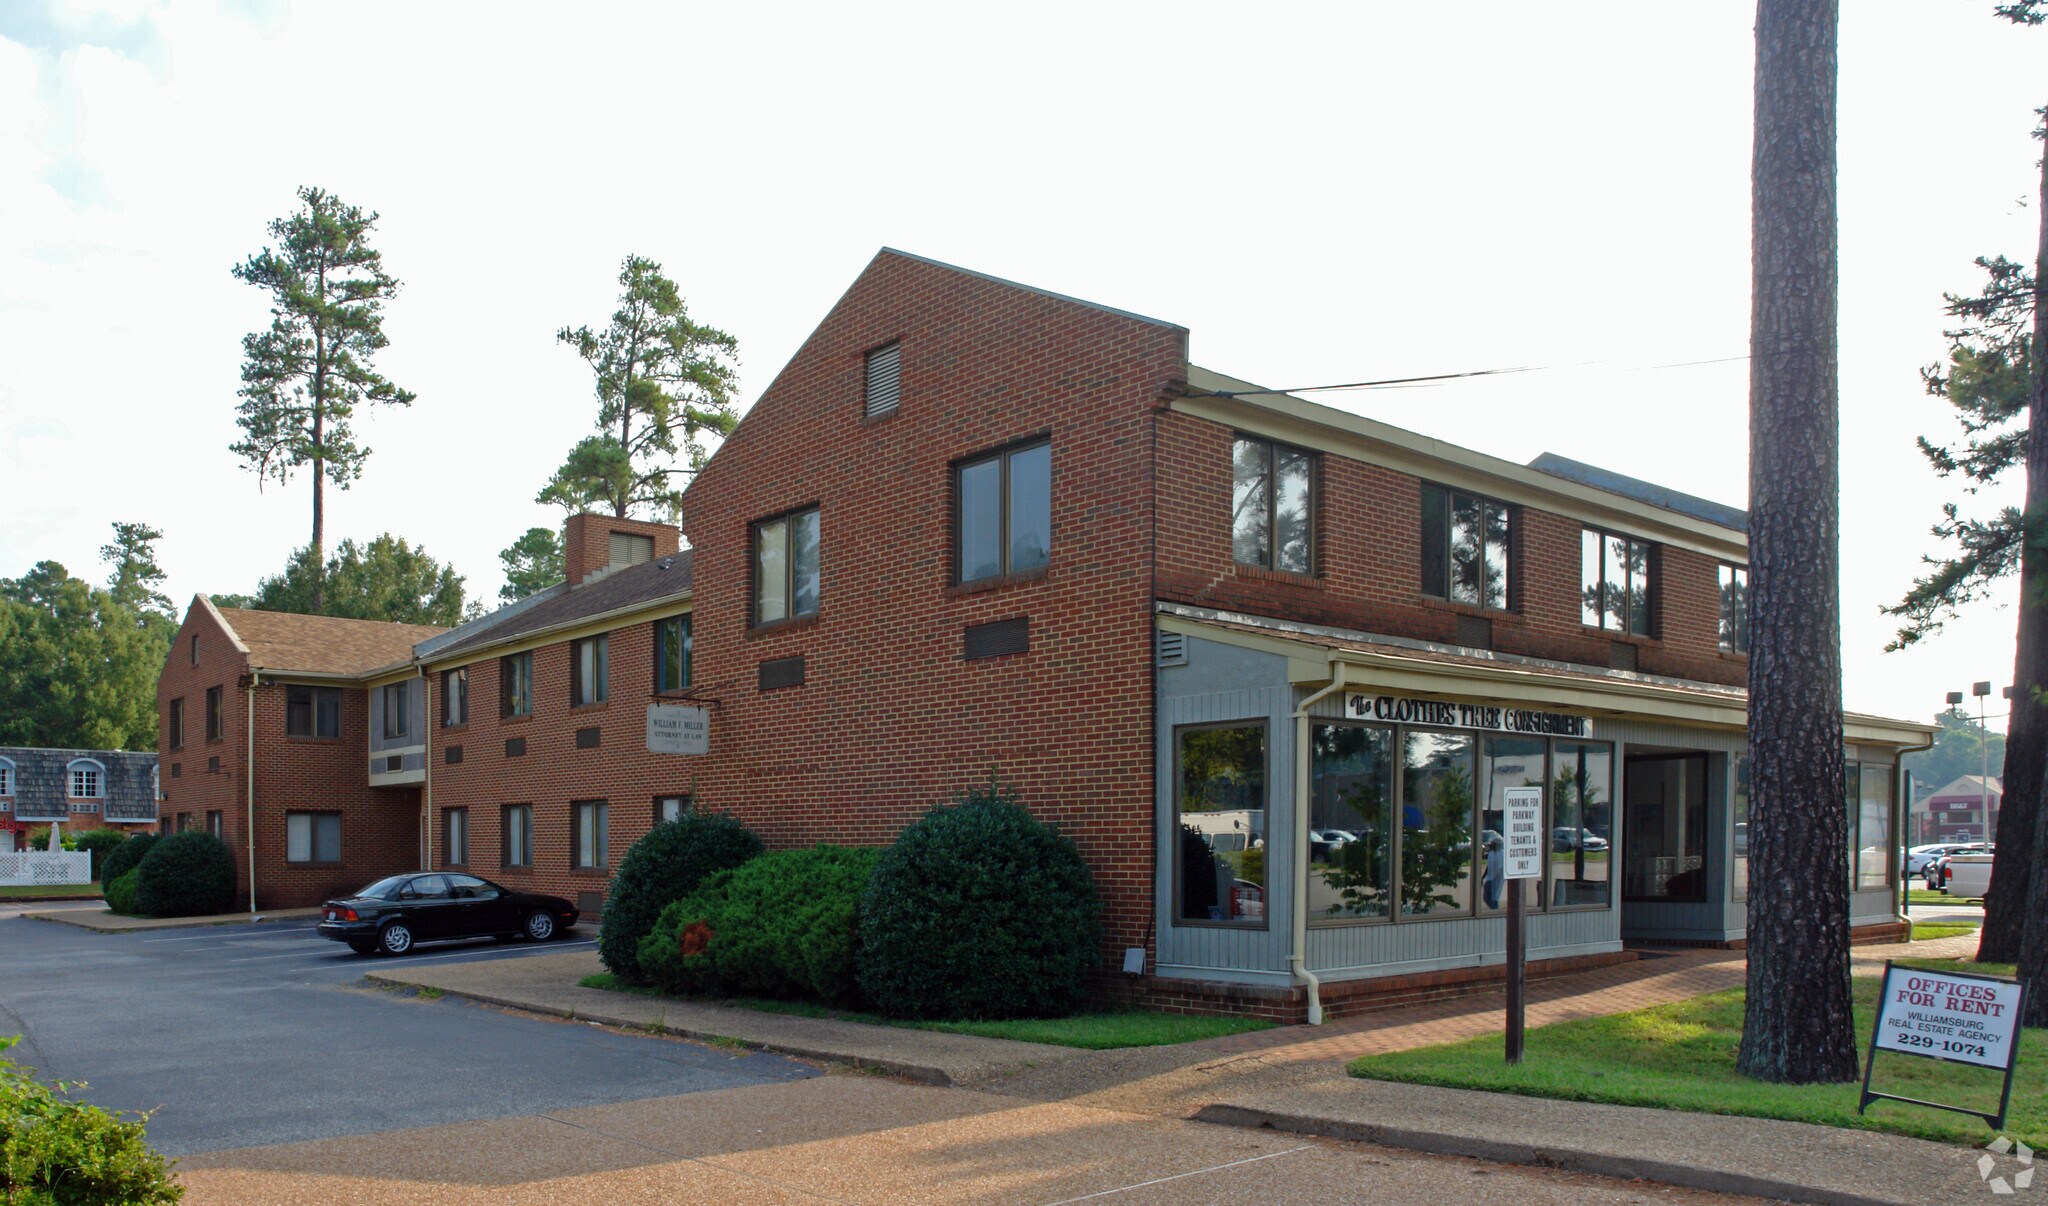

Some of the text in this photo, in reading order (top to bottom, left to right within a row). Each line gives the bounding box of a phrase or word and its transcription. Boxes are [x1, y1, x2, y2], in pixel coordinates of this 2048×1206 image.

[1375, 696, 1455, 725] CLOTHES
[1460, 704, 1500, 729] TREE
[1504, 708, 1584, 736] CONSIGNMENT
[653, 719, 677, 728] WILLIAM
[684, 721, 704, 730] MILLER
[654, 731, 682, 739] ATTORNEY
[1508, 798, 1539, 807] PARKING FOR
[1512, 810, 1535, 820] PARKWAY
[1513, 823, 1534, 833] BUILDING
[1510, 836, 1532, 845] TENANTS
[1509, 848, 1537, 858] CUSTOMERS
[1517, 861, 1529, 870] ONLY
[1907, 977, 1997, 1001] OFFICES
[1896, 990, 2005, 1018] FOR RENT
[1907, 1011, 1985, 1031] WILLIAMSBURG
[1887, 1017, 2002, 1043] REAL ESTATE AGENCY
[1897, 1033, 1986, 1057] 229-1074
